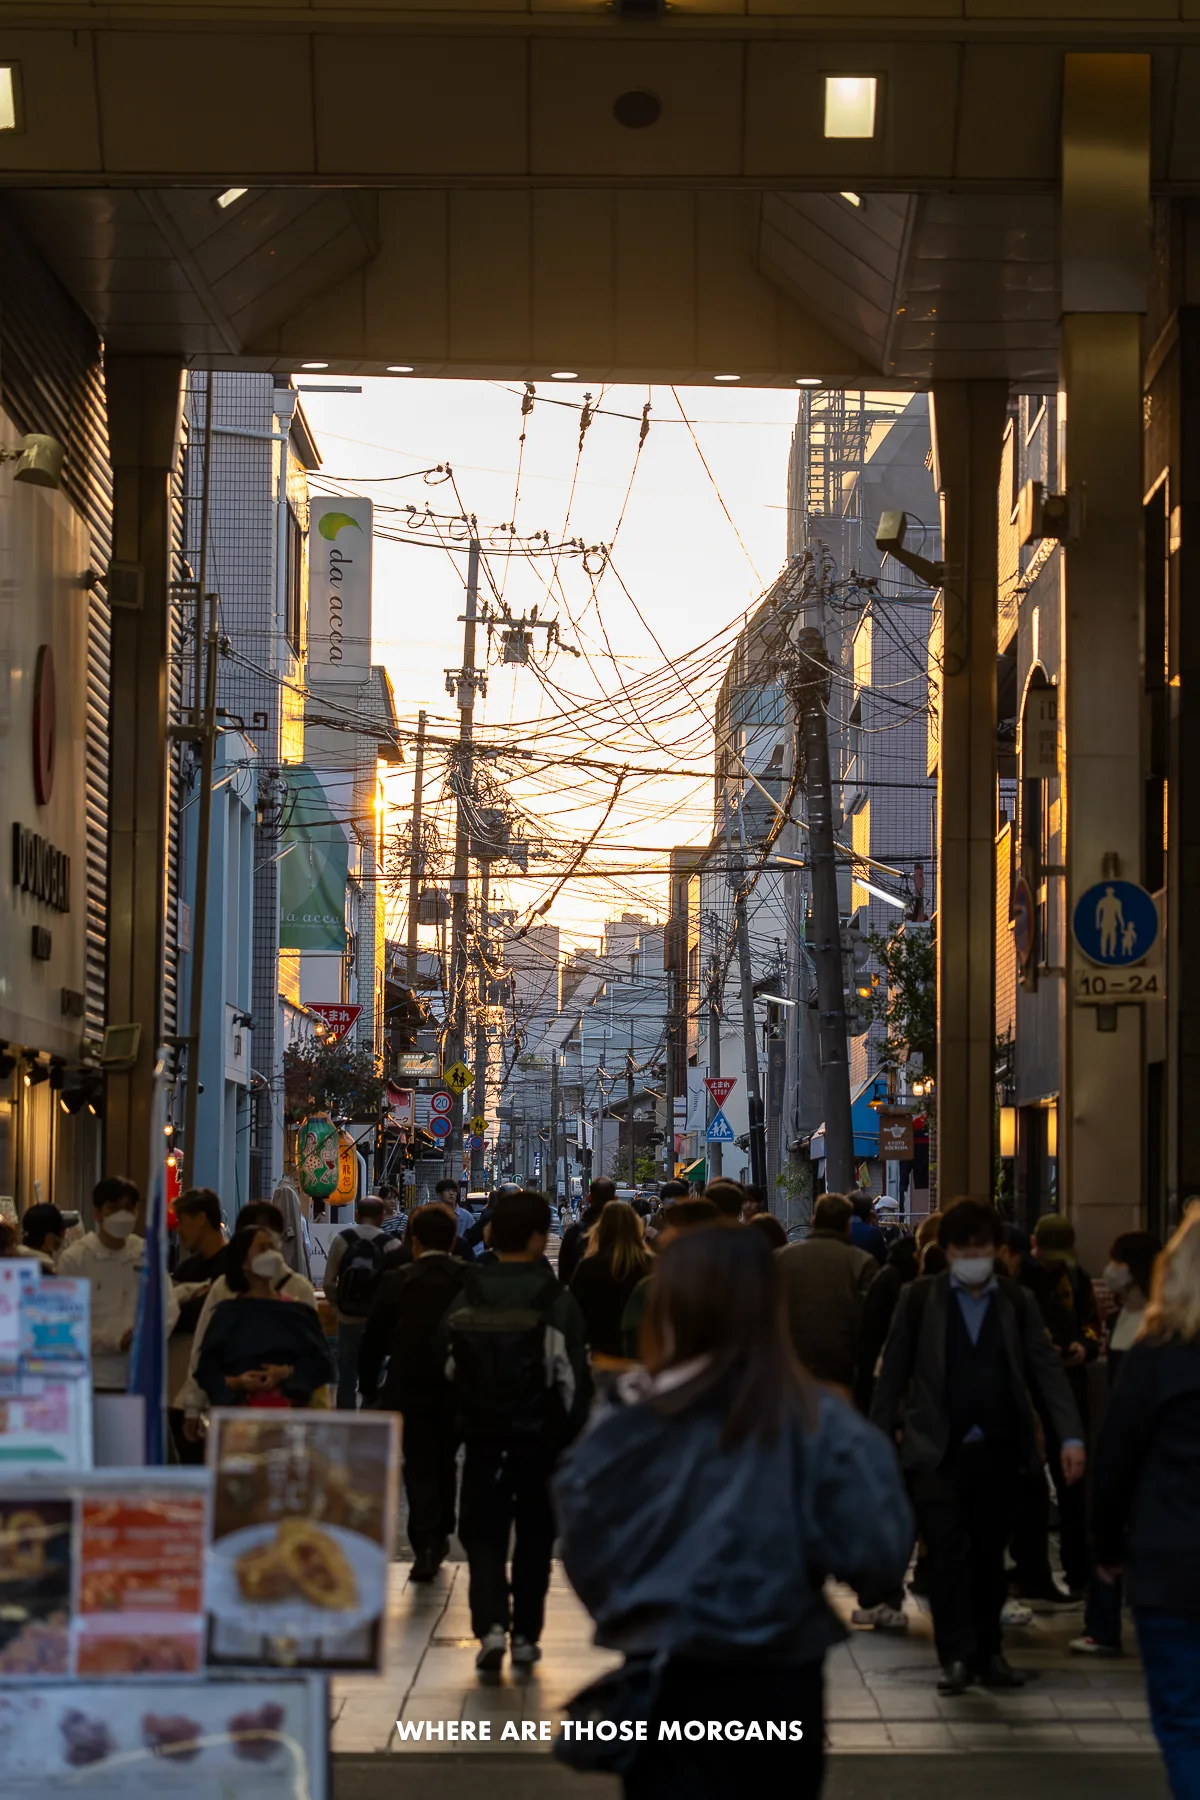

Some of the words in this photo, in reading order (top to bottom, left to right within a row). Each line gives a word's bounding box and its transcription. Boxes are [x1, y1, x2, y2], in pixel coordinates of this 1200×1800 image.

[329, 549, 353, 589] da
[329, 595, 343, 668] acca
[710, 1080, 731, 1089] 止まれ
[435, 1098, 448, 1109] 20
